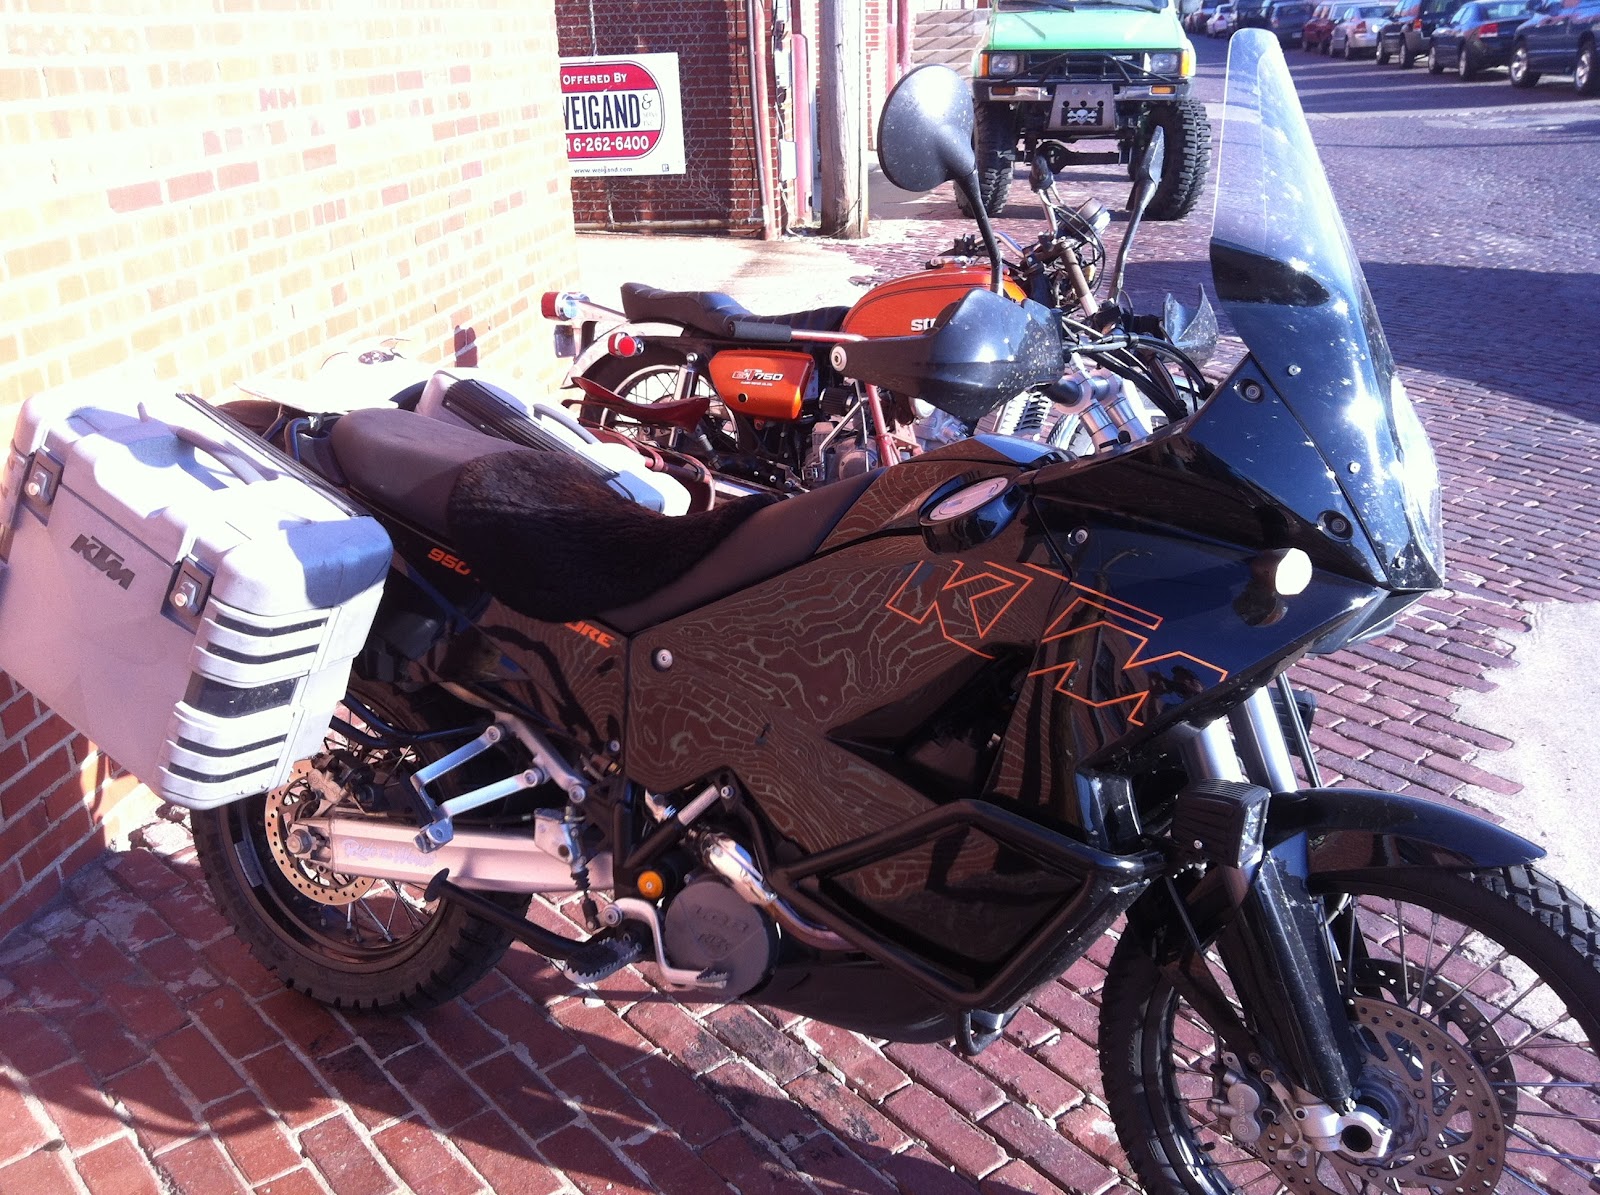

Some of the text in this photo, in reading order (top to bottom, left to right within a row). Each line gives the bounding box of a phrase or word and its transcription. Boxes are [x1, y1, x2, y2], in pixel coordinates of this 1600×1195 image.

[573, 166, 633, 174] www.weigand.com
[70, 533, 136, 591] KTM
[884, 559, 1229, 728] KTM
